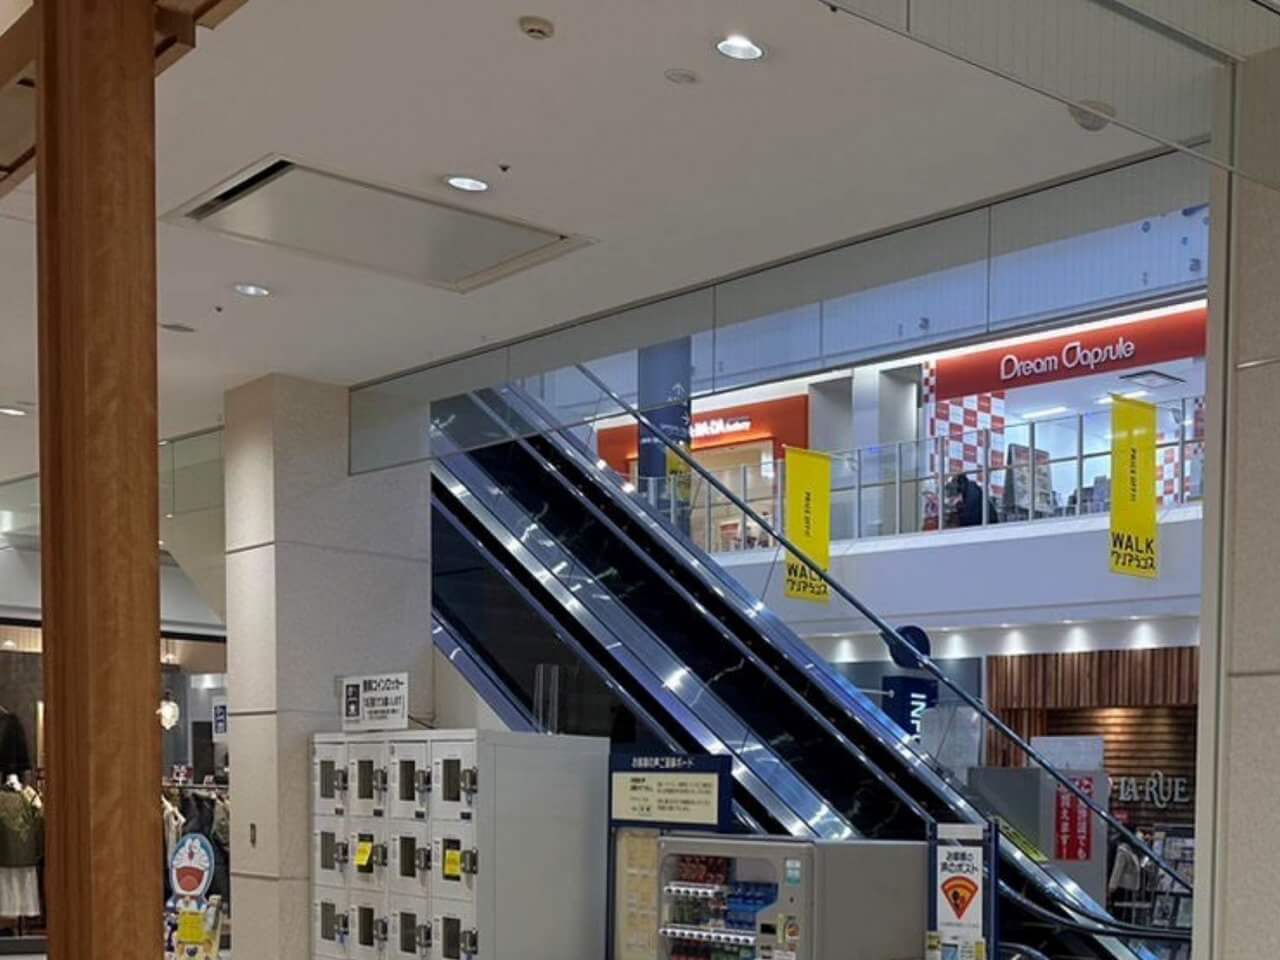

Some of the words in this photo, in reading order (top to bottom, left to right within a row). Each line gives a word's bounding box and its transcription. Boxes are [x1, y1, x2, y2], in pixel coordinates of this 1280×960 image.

[1001, 354, 1058, 380] Dream
[1062, 337, 1135, 369] Capsule
[1111, 531, 1155, 555] WALK
[910, 693, 927, 741] INF
